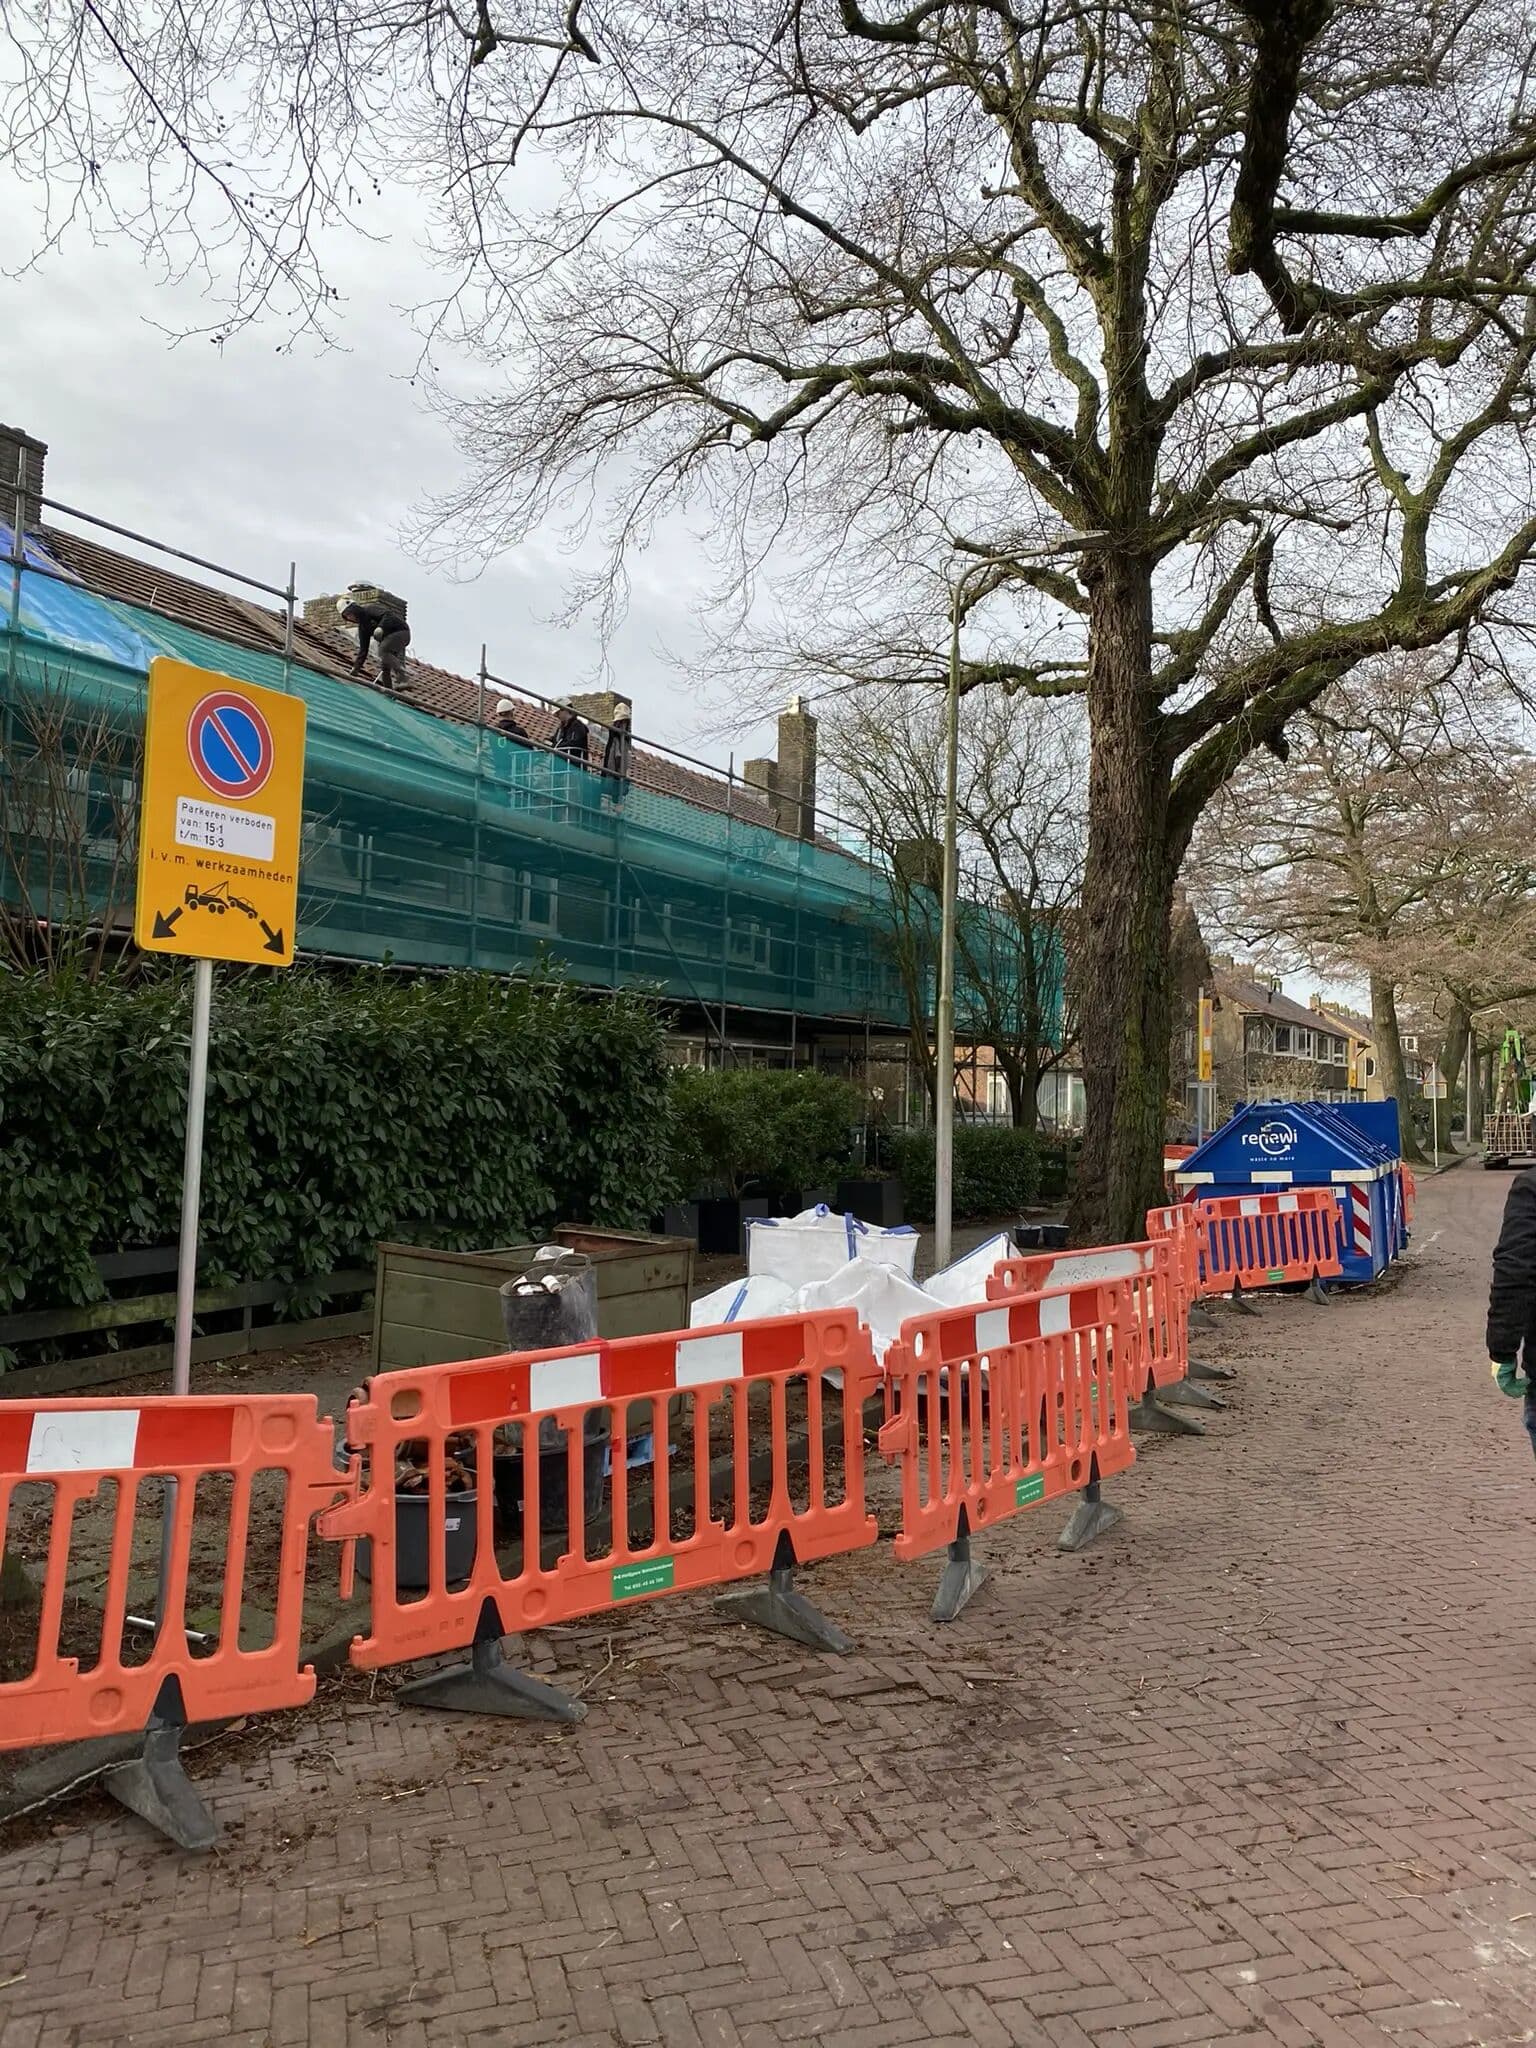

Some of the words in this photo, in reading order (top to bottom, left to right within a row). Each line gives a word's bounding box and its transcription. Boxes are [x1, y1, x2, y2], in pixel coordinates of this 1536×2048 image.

[182, 803, 226, 820] Parkeren
[229, 815, 272, 830] verboden
[196, 858, 293, 885] werkzaamheden
